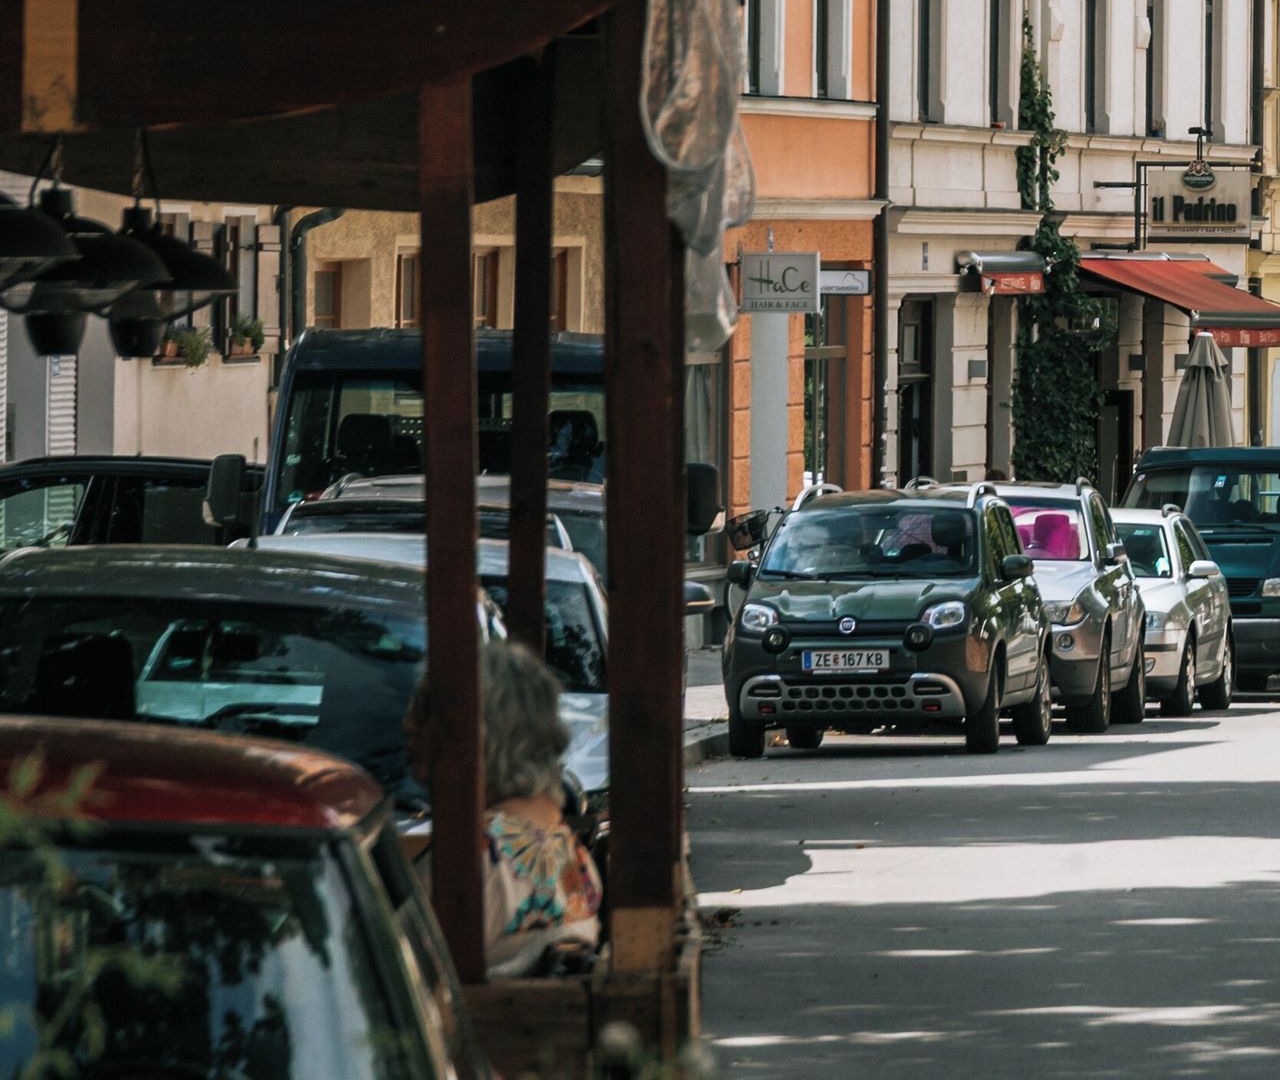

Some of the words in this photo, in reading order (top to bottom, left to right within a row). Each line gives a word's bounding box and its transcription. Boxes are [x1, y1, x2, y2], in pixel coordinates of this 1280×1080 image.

[1152, 196, 1164, 222] il
[1173, 195, 1236, 222] Padrino
[751, 300, 774, 309] HAIR
[775, 300, 782, 309] &
[784, 300, 808, 309] FACE
[815, 652, 831, 667] ZE
[841, 652, 864, 666] 167
[865, 652, 883, 666] KB
